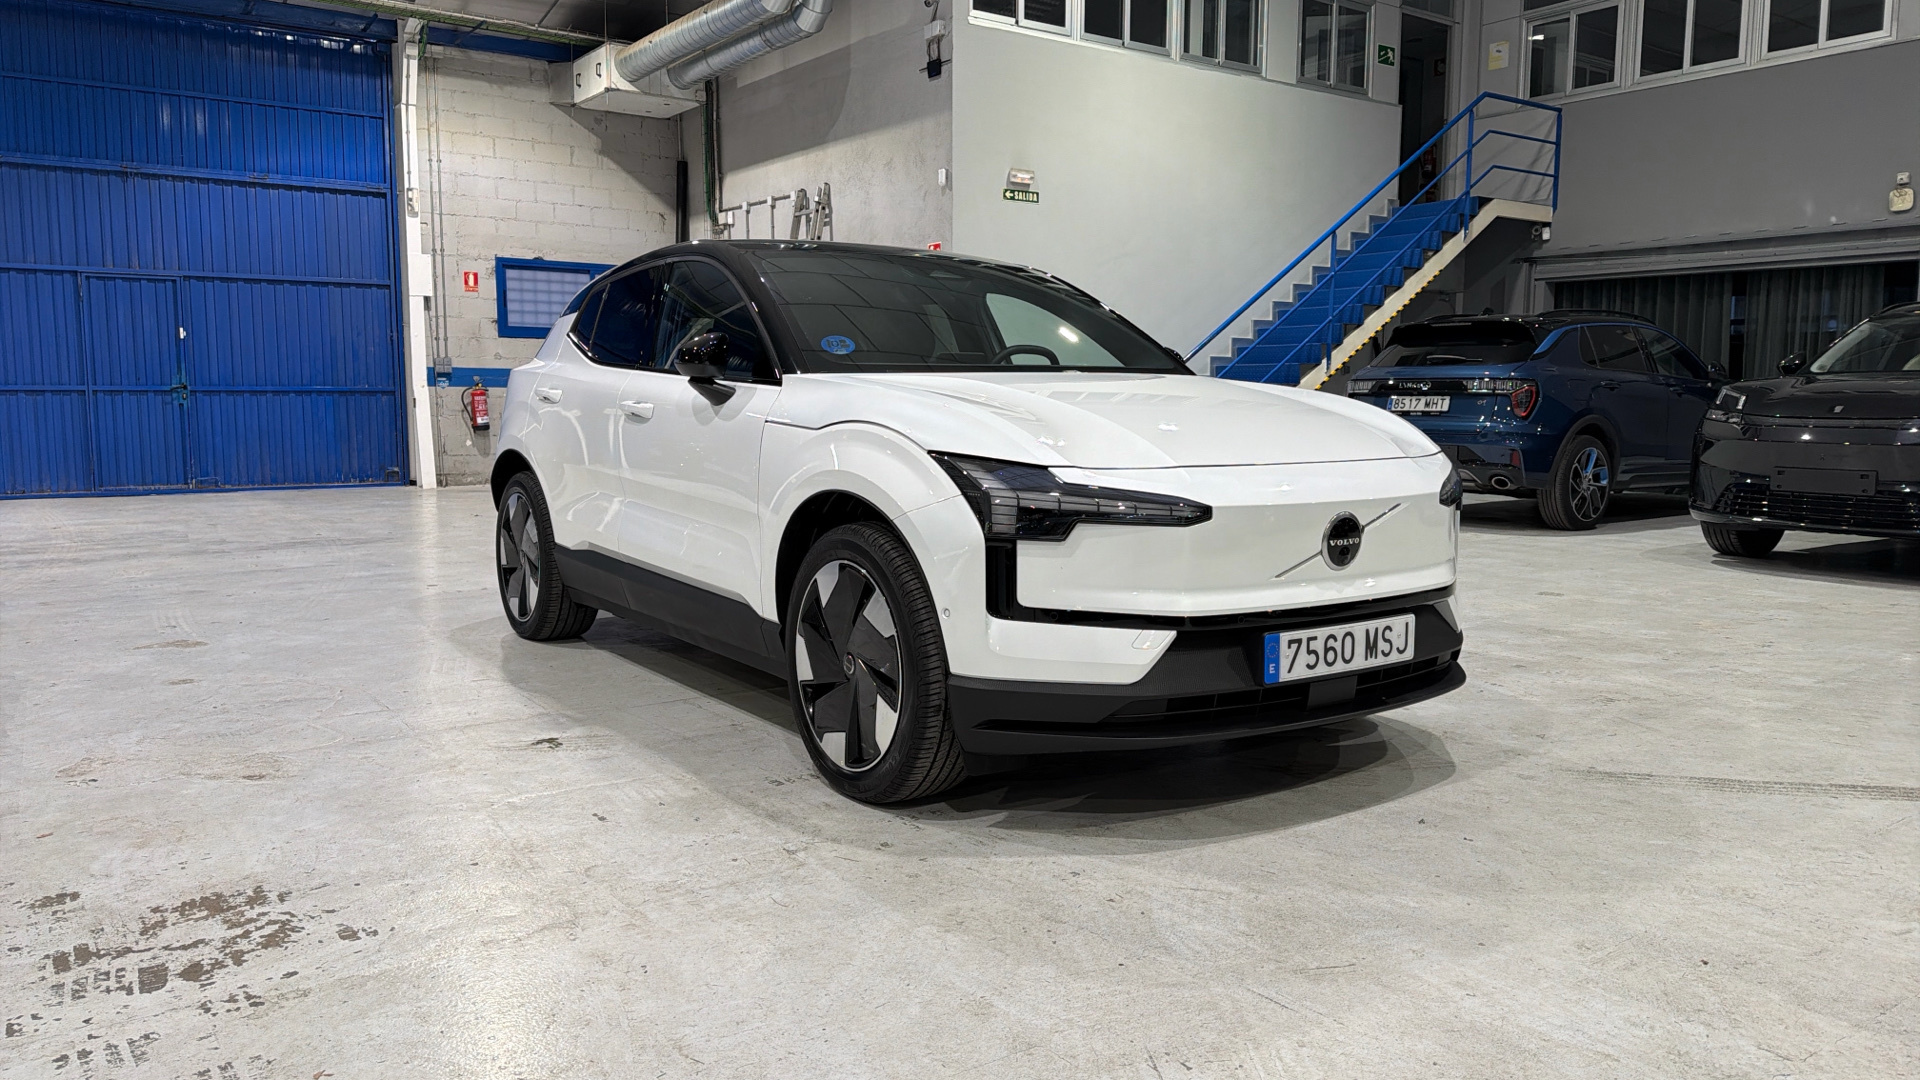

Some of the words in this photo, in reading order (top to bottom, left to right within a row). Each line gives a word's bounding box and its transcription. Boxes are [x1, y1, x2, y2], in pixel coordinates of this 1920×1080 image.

[1014, 191, 1038, 202] SALIDA
[1393, 398, 1421, 409] 8517
[1423, 398, 1447, 409] MHT
[1329, 537, 1360, 547] VOLVO
[1287, 631, 1355, 674] 7560
[1364, 621, 1409, 661] MSJ
[1269, 663, 1276, 674] E
